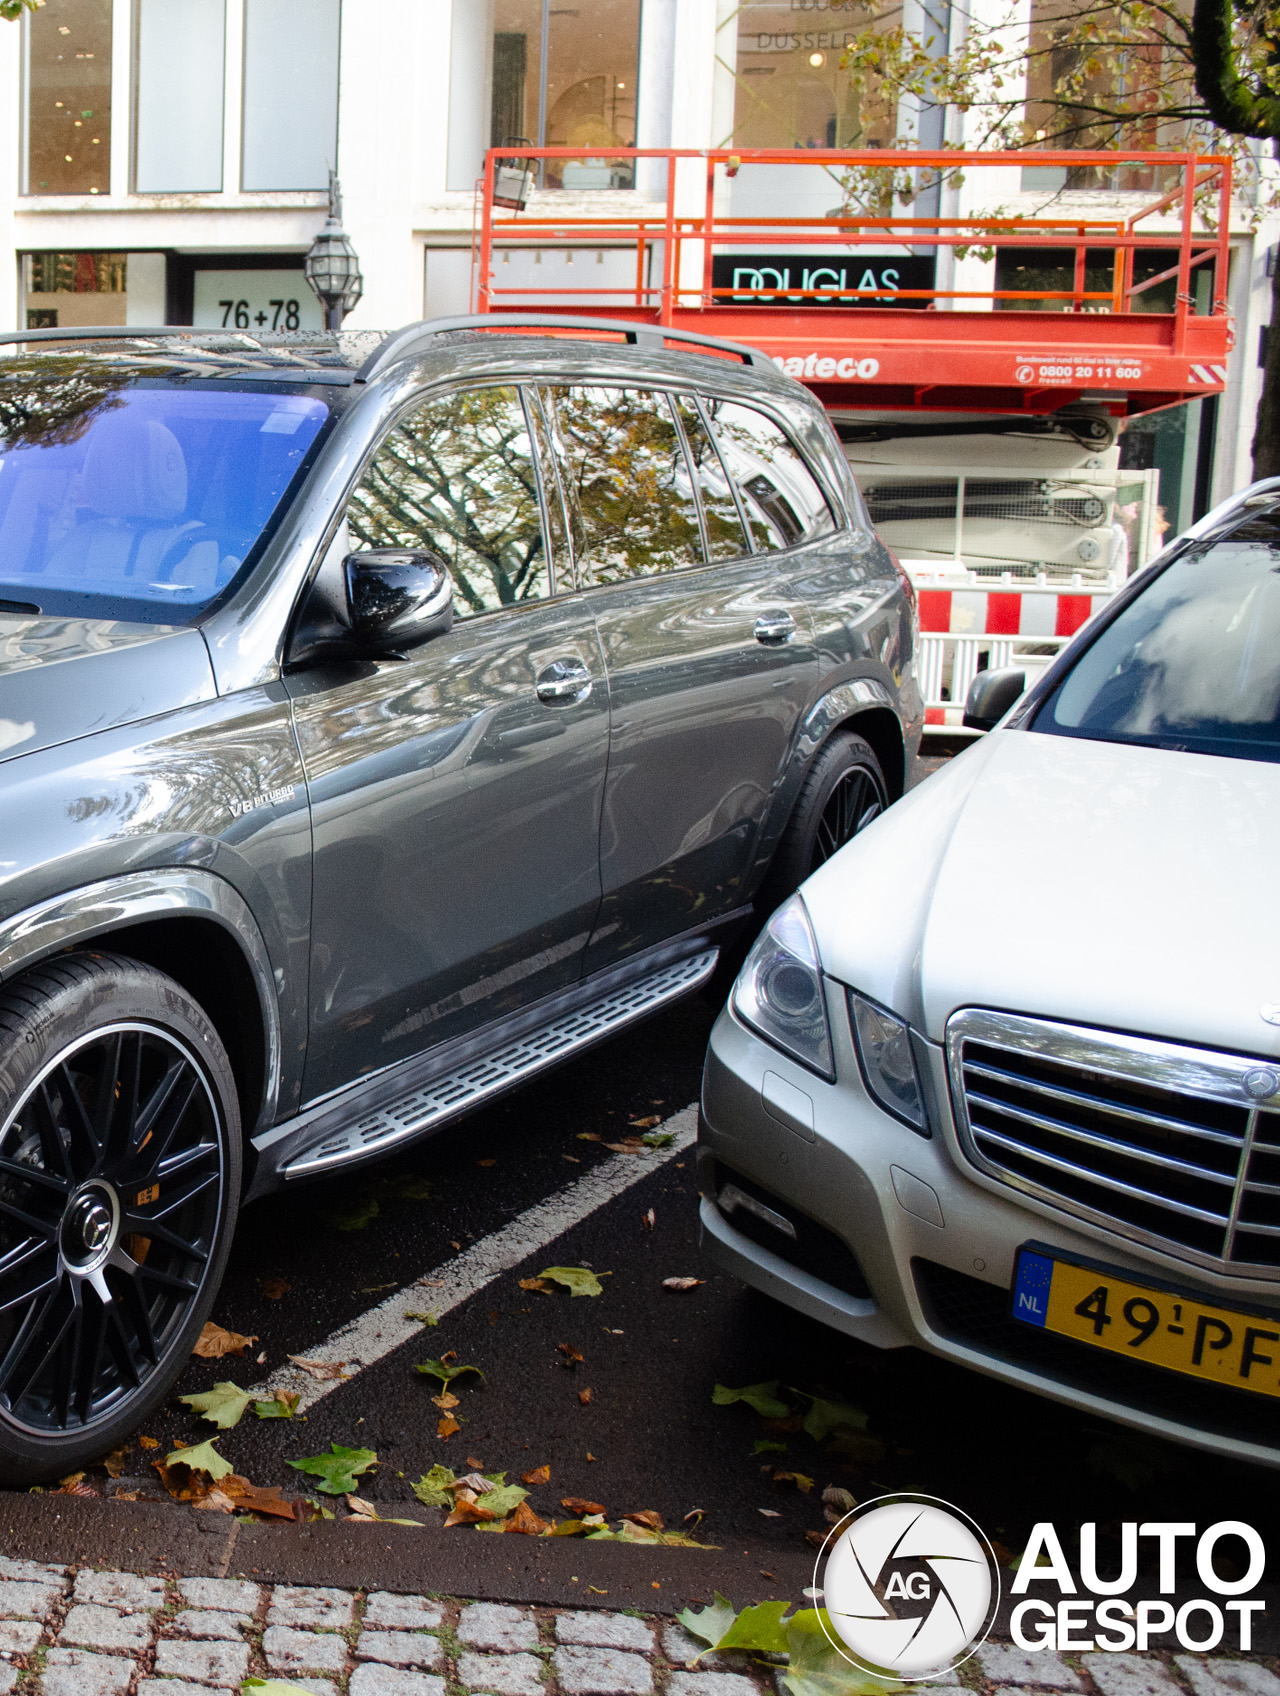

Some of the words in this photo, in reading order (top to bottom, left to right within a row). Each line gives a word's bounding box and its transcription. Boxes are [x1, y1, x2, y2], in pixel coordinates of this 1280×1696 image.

[757, 28, 857, 49] DÜSSELD
[732, 267, 900, 302] DOUGLAS
[1039, 365, 1073, 377] 0800
[1075, 366, 1093, 378] 20
[1096, 367, 1112, 378] 11
[1115, 367, 1141, 379] 600
[228, 799, 254, 818] V8
[254, 784, 294, 805] BITURBO
[1018, 1292, 1042, 1314] NL
